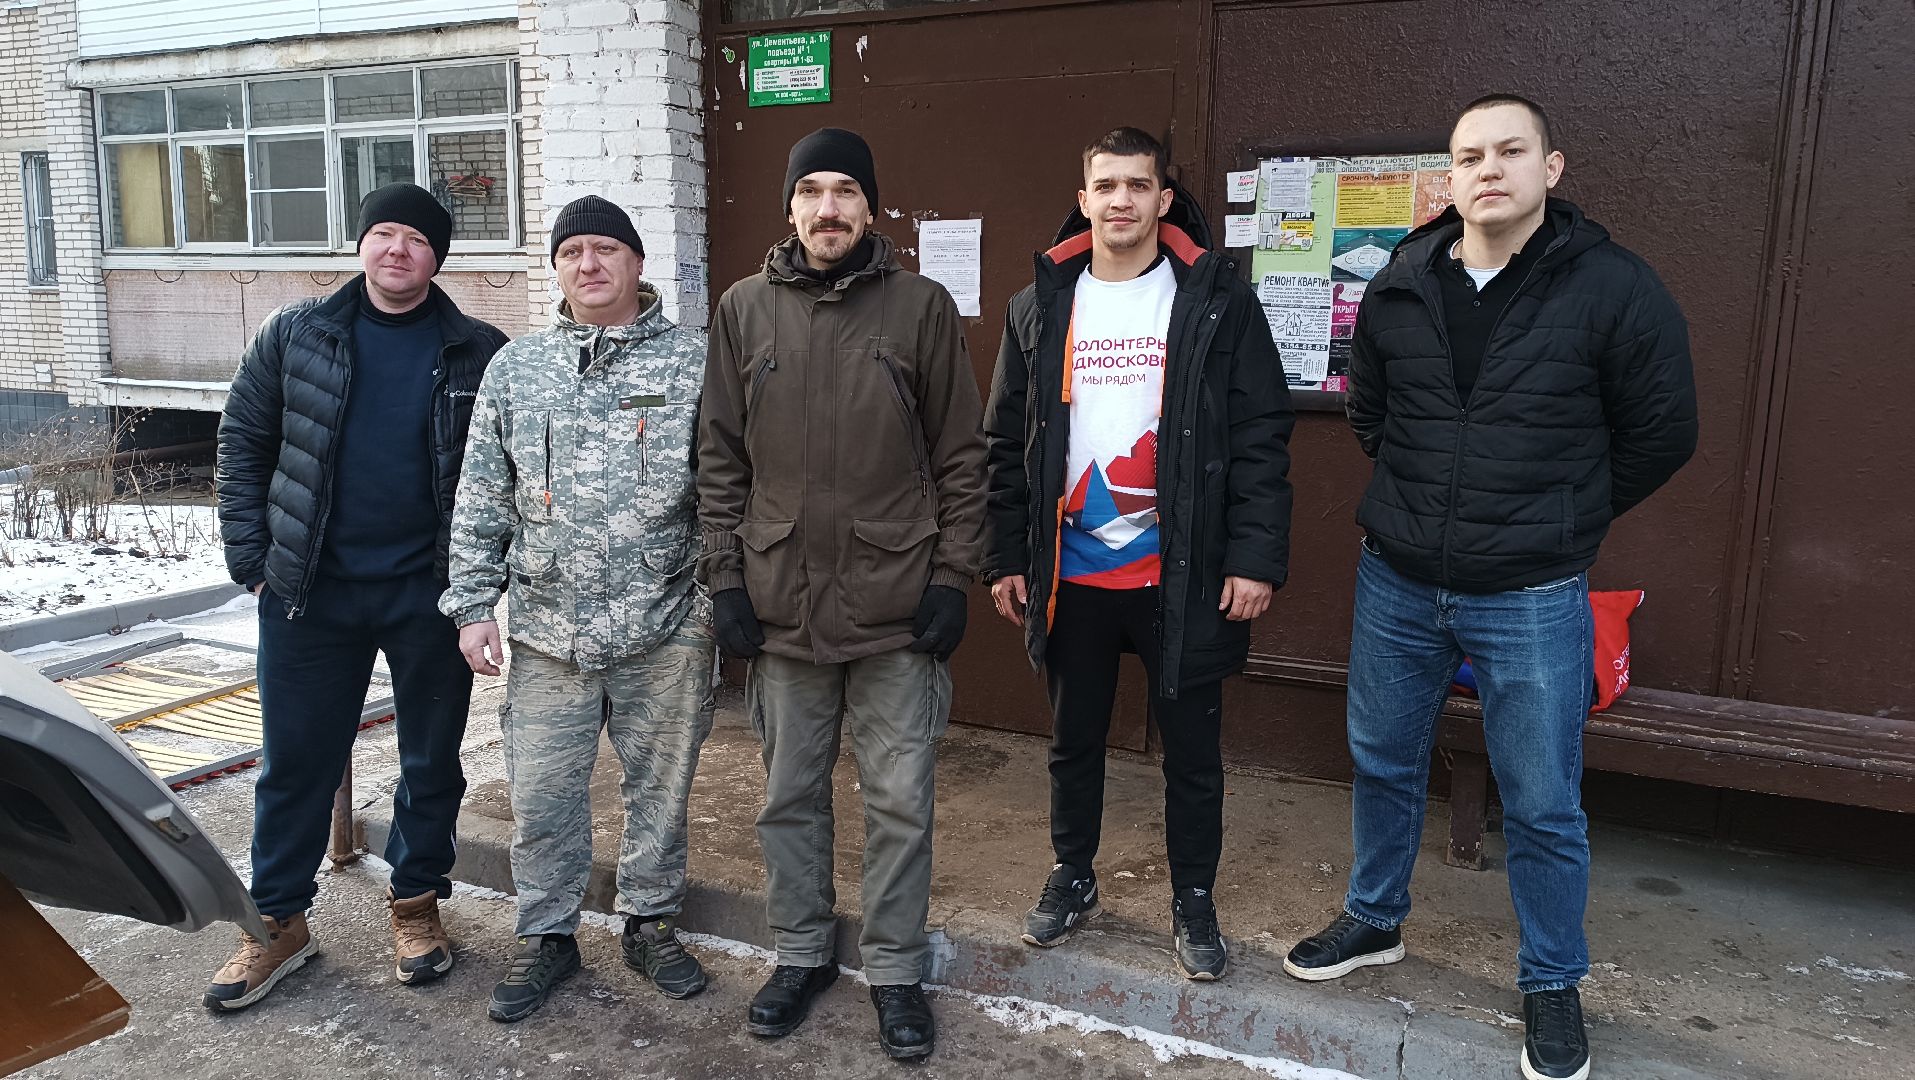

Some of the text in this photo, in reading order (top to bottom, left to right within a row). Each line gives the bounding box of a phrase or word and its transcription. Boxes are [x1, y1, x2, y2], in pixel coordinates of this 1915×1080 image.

[764, 36, 808, 48] Дементьева,
[767, 48, 796, 57] подъезд
[764, 58, 792, 67] квартиры
[1341, 157, 1415, 165] ИГЛАШАЮТСЯ
[1264, 275, 1330, 288] РЕМОНТ КВАРТИР
[1072, 354, 1164, 371] ДМОСКОВ
[1081, 373, 1146, 386] МЫ РЯДОМ
